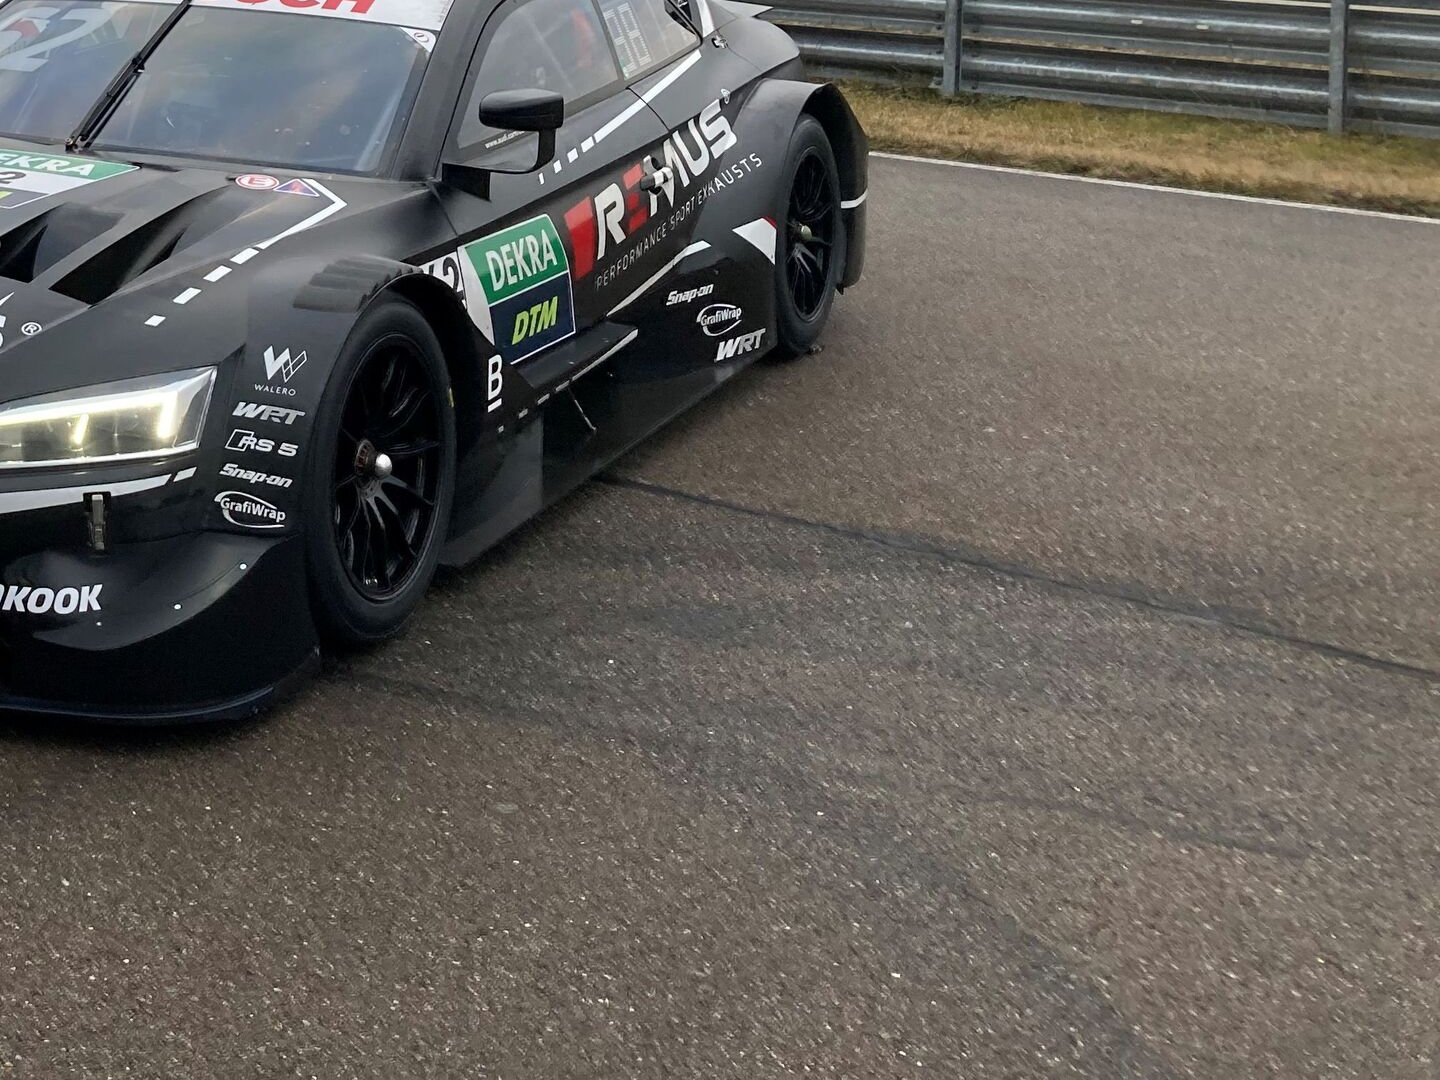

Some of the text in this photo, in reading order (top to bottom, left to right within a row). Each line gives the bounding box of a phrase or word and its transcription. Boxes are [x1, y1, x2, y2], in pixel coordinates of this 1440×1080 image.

[595, 221, 668, 291] PERFORMANCE
[669, 196, 696, 230] SPORT
[484, 228, 558, 292] DEKRA
[666, 283, 714, 306] Snap-on
[511, 295, 558, 346] DTM
[700, 307, 742, 327] GrafiWrap
[713, 328, 766, 363] WRT
[254, 383, 297, 396] WALERO
[487, 354, 503, 401] B
[231, 401, 306, 425] WRT
[277, 442, 299, 457] 5
[219, 463, 293, 488] Snap-on
[220, 497, 287, 523] GrafiWrap
